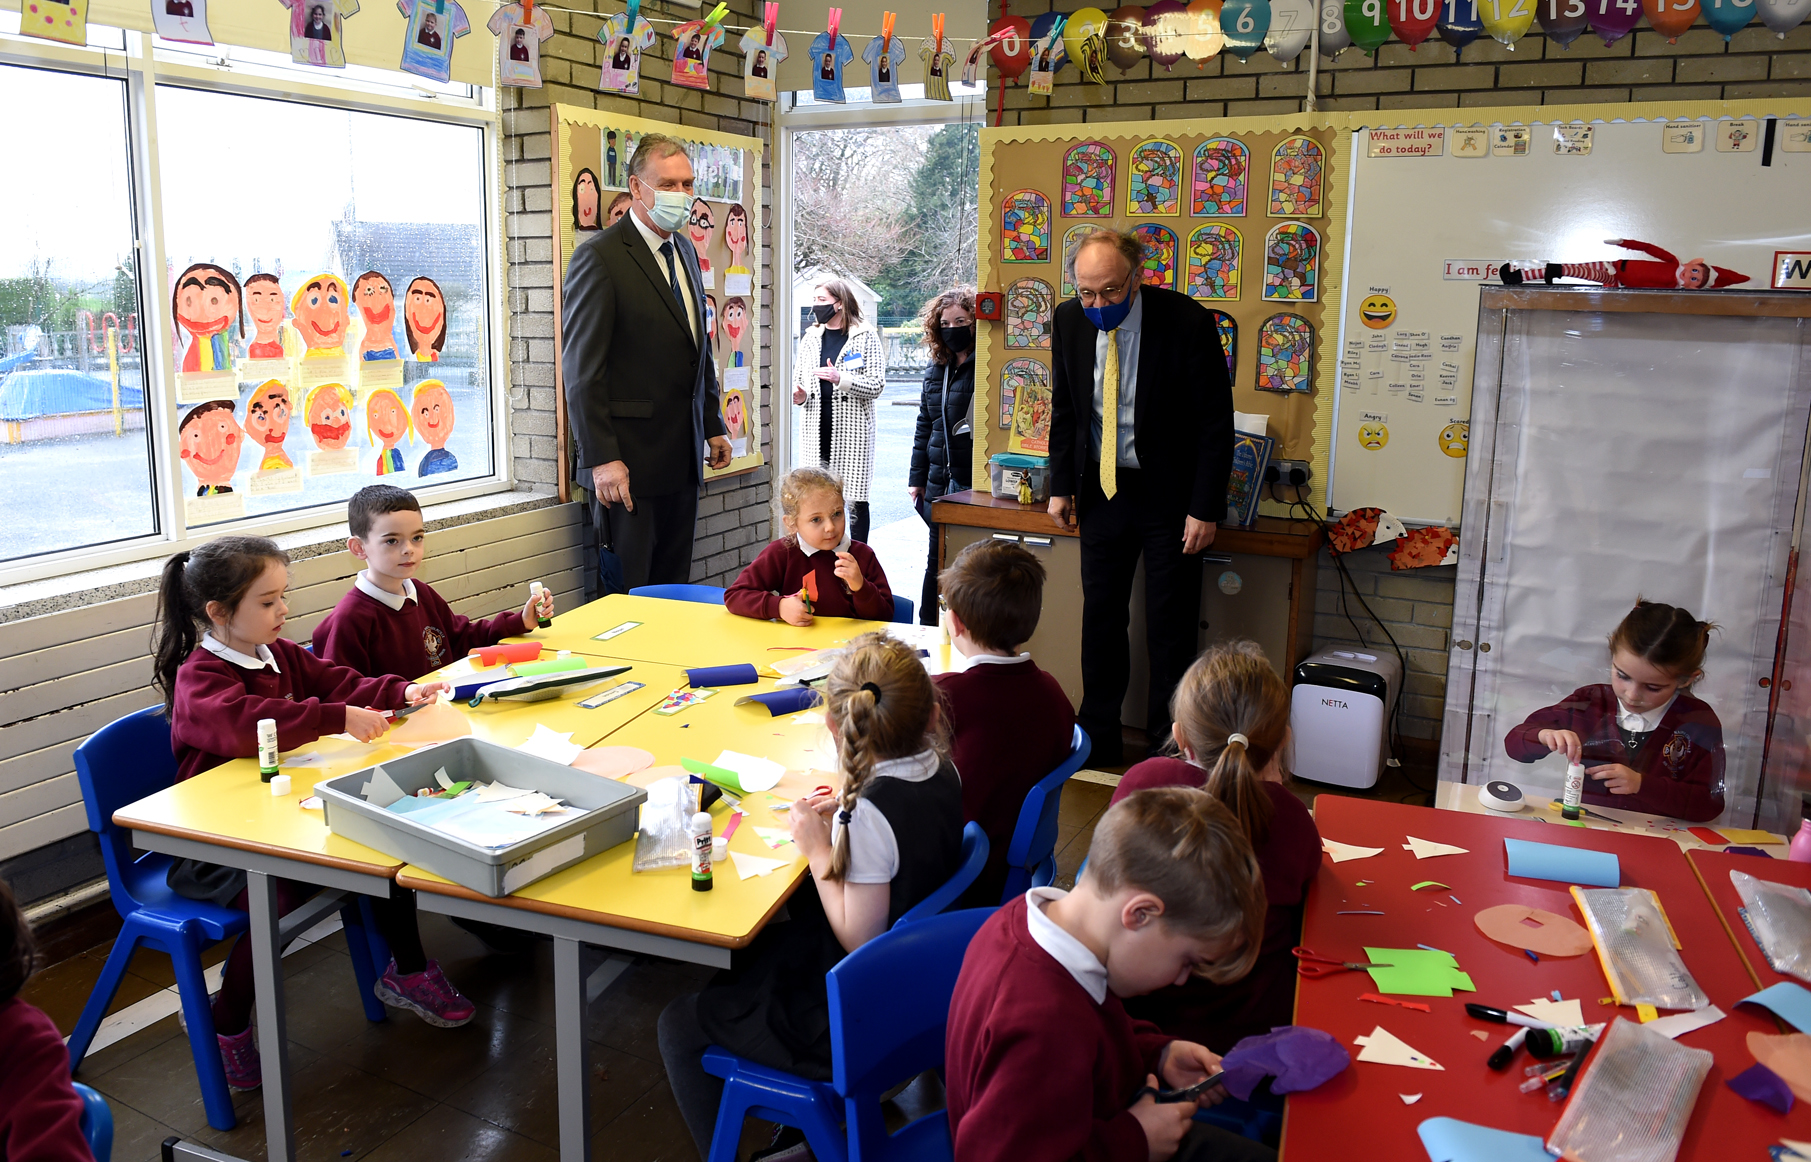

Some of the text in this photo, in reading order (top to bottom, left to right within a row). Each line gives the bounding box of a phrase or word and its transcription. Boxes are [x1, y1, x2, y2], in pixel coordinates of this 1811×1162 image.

[1236, 6, 1254, 34] 6
[1321, 6, 1341, 34] 8
[1361, 0, 1380, 27] 9
[1396, 0, 1434, 22] 10
[1444, 0, 1478, 23] 11
[1118, 20, 1136, 48] 3
[1279, 10, 1298, 38] 7
[1003, 29, 1020, 56] 0
[1370, 131, 1401, 141] What
[1403, 130, 1425, 140] will
[1379, 143, 1433, 157] do today?
[1446, 263, 1452, 275] I
[1457, 266, 1480, 276] am
[1369, 286, 1389, 294] Happy
[1363, 413, 1382, 421] Angry
[1449, 417, 1470, 425] Scared
[1321, 698, 1349, 710] NETTA
